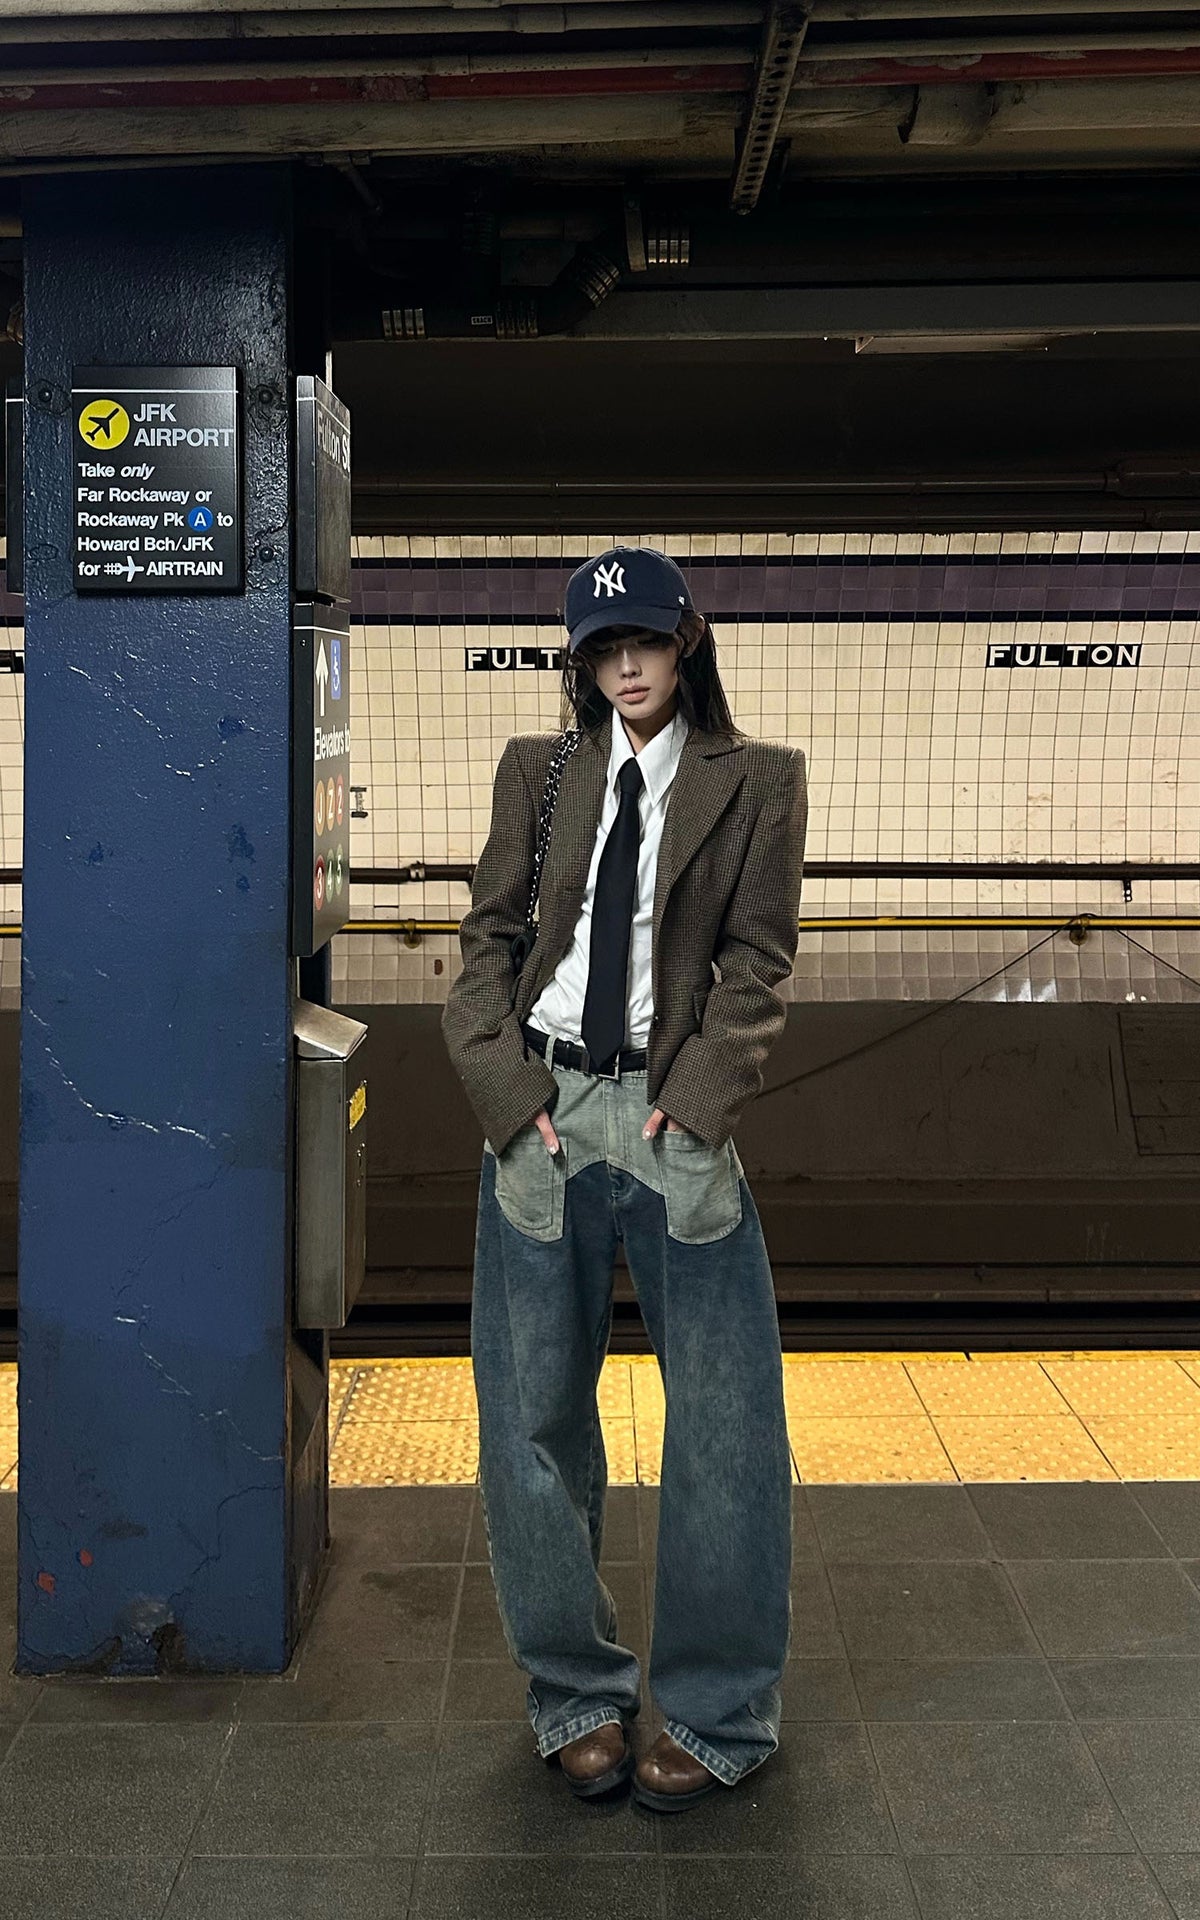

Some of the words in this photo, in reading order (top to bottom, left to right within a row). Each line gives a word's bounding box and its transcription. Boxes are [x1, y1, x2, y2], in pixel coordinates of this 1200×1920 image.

[133, 403, 177, 422] JFK
[133, 428, 234, 447] AIRPORT
[317, 409, 341, 464] Fulton
[78, 462, 116, 478] Take
[120, 462, 156, 480] only
[77, 487, 105, 502] Far
[108, 487, 190, 505] Rockaway
[195, 489, 213, 502] or
[77, 511, 159, 530] Rockaway
[163, 511, 185, 527] Pk
[193, 511, 207, 527] A
[216, 511, 234, 527] to
[77, 536, 140, 552] Howard
[144, 536, 214, 552] Bch/JFK
[77, 561, 101, 576] for
[145, 561, 224, 576] AIRTRAIN
[593, 561, 627, 598] NY
[467, 649, 560, 669] FULT
[988, 644, 1139, 667] FULTON
[314, 724, 345, 761] Elevators
